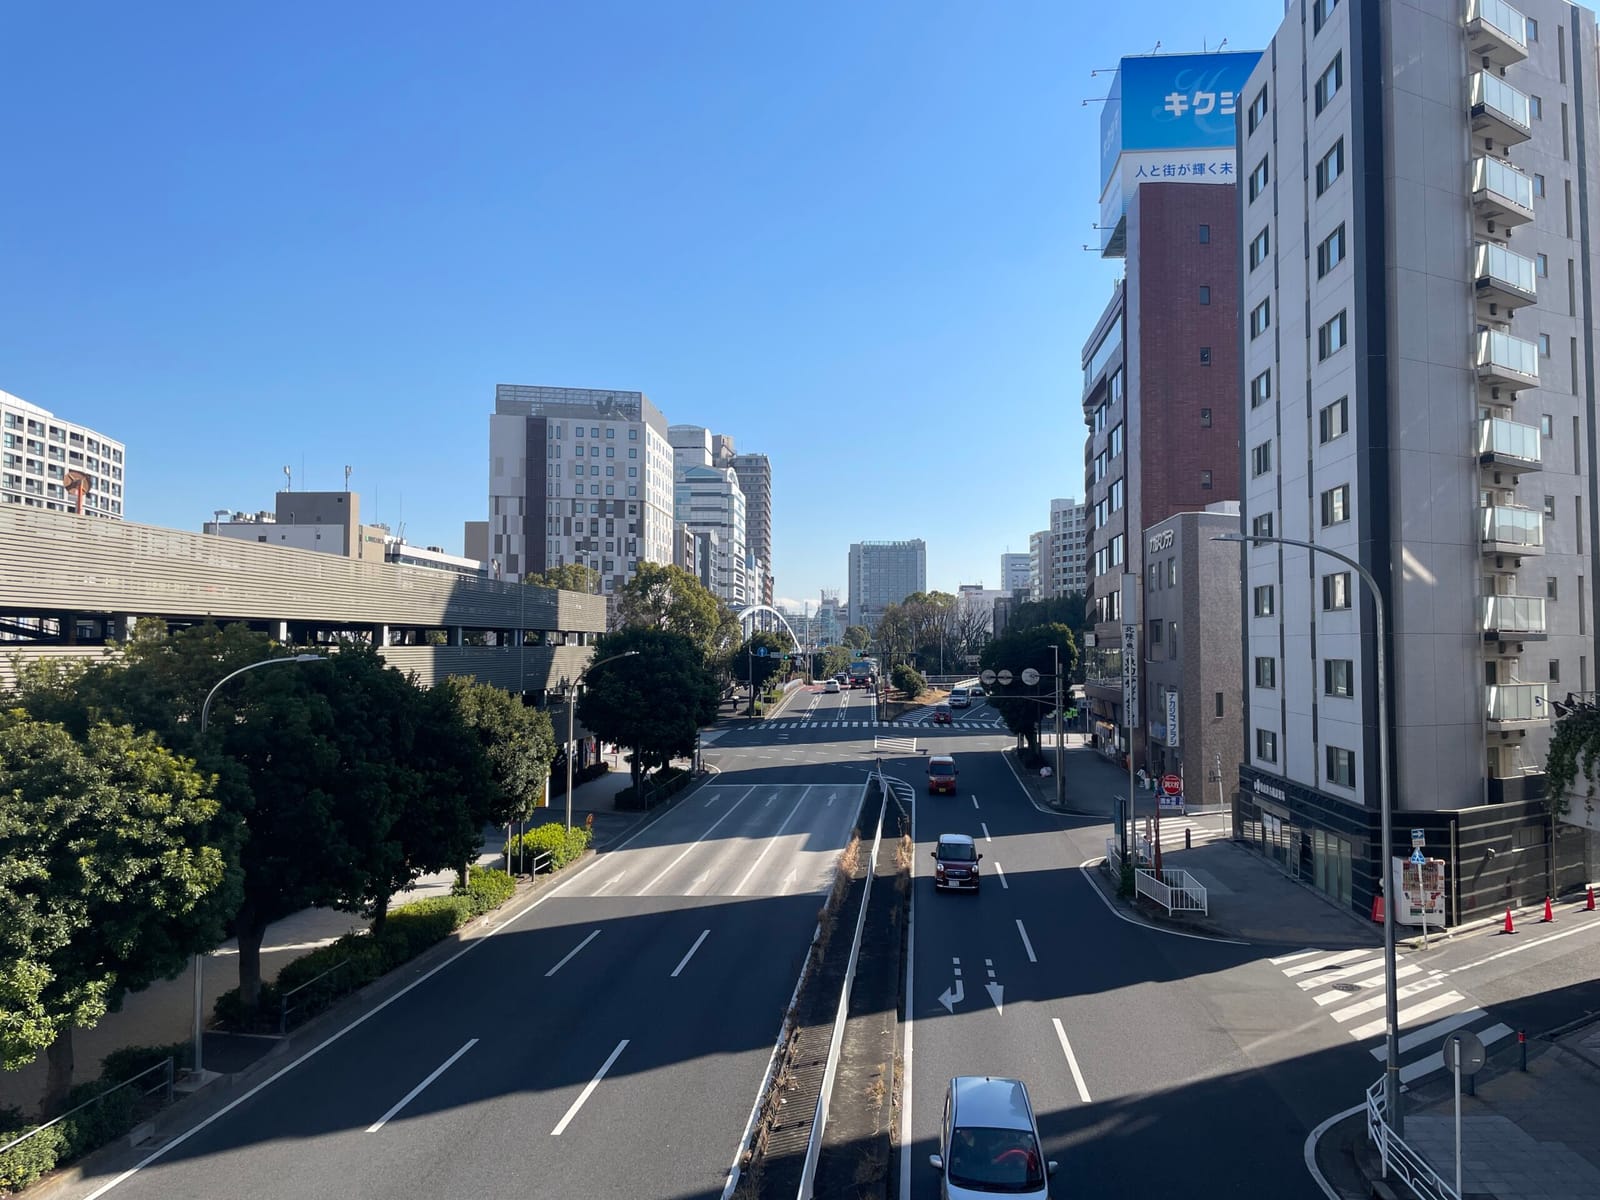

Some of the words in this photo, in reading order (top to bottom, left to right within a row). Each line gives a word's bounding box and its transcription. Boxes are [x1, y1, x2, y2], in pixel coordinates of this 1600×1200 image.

[1135, 161, 1233, 178] 人と街が輝く未
